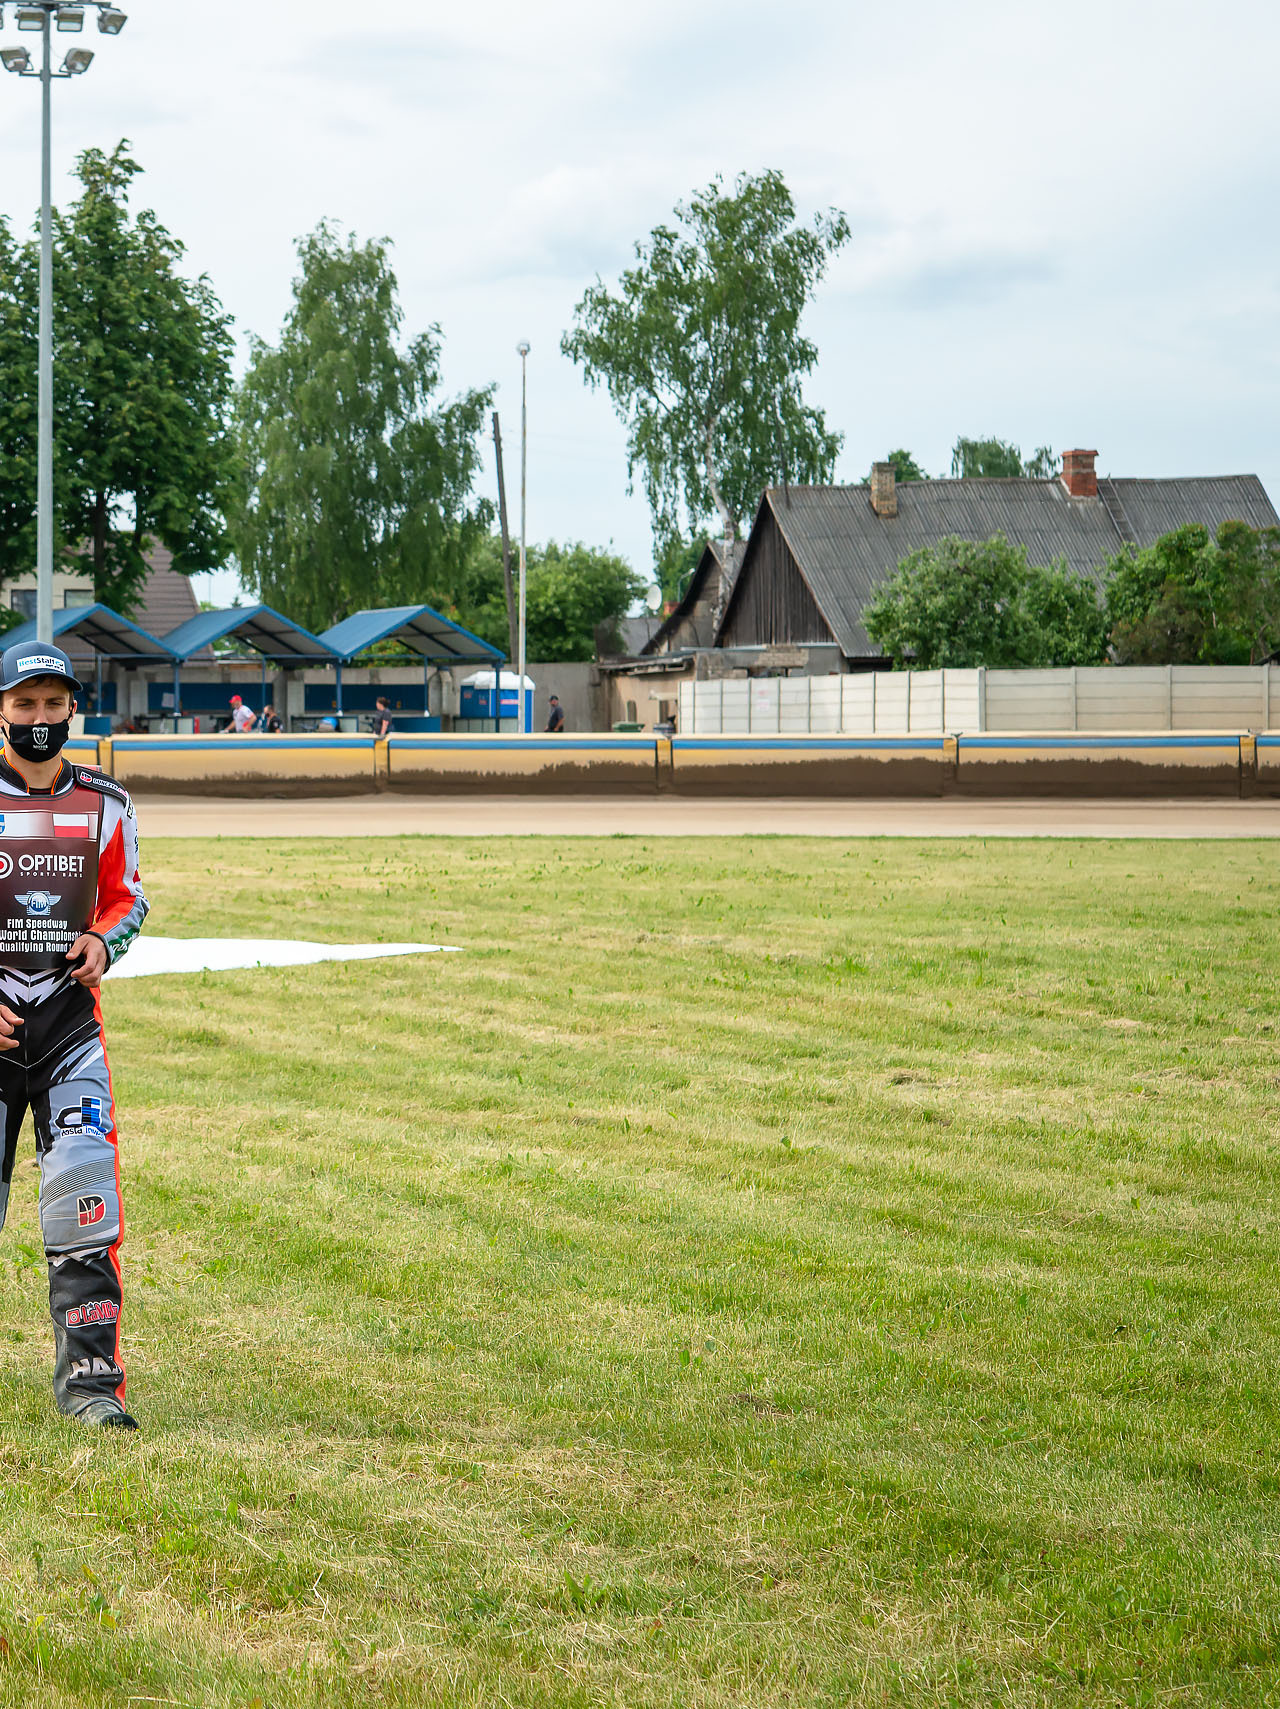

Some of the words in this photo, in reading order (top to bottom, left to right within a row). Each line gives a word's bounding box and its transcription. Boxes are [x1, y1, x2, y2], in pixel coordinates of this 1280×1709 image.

[18, 854, 85, 873] OPTIBET
[7, 919, 24, 929] FIM
[26, 919, 68, 930] Speedway
[30, 930, 83, 942] Championshi
[0, 942, 44, 953] Qualifying
[46, 943, 68, 952] Round
